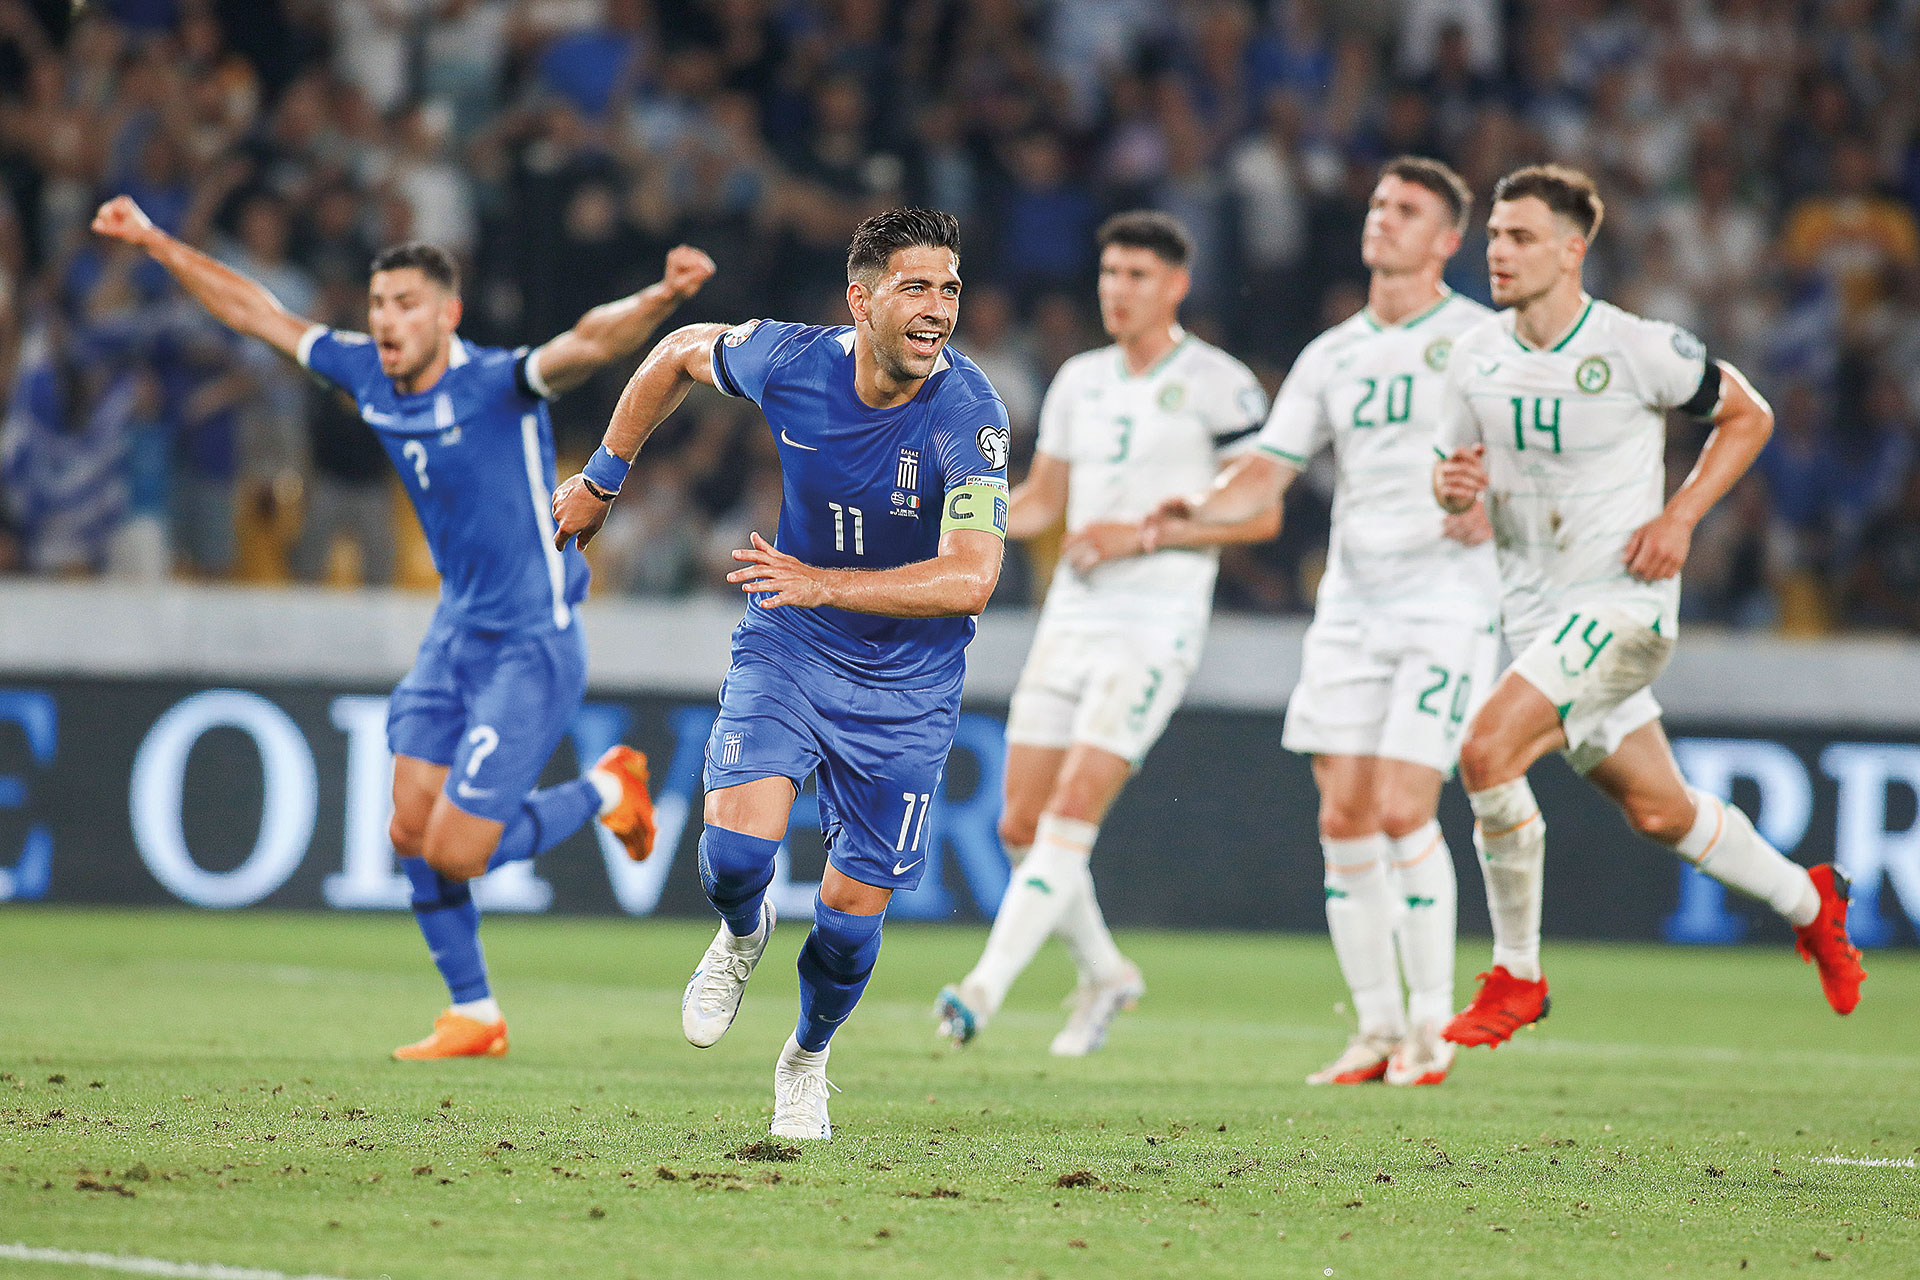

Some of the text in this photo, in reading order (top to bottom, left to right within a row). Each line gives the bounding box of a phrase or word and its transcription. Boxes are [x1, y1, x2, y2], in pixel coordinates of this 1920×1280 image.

[1353, 374, 1413, 428] 20
[1511, 397, 1561, 454] 14
[1109, 414, 1132, 464] 3
[828, 501, 864, 555] 11
[949, 493, 974, 519] C
[1553, 613, 1613, 669] 14
[896, 792, 930, 852] 11
